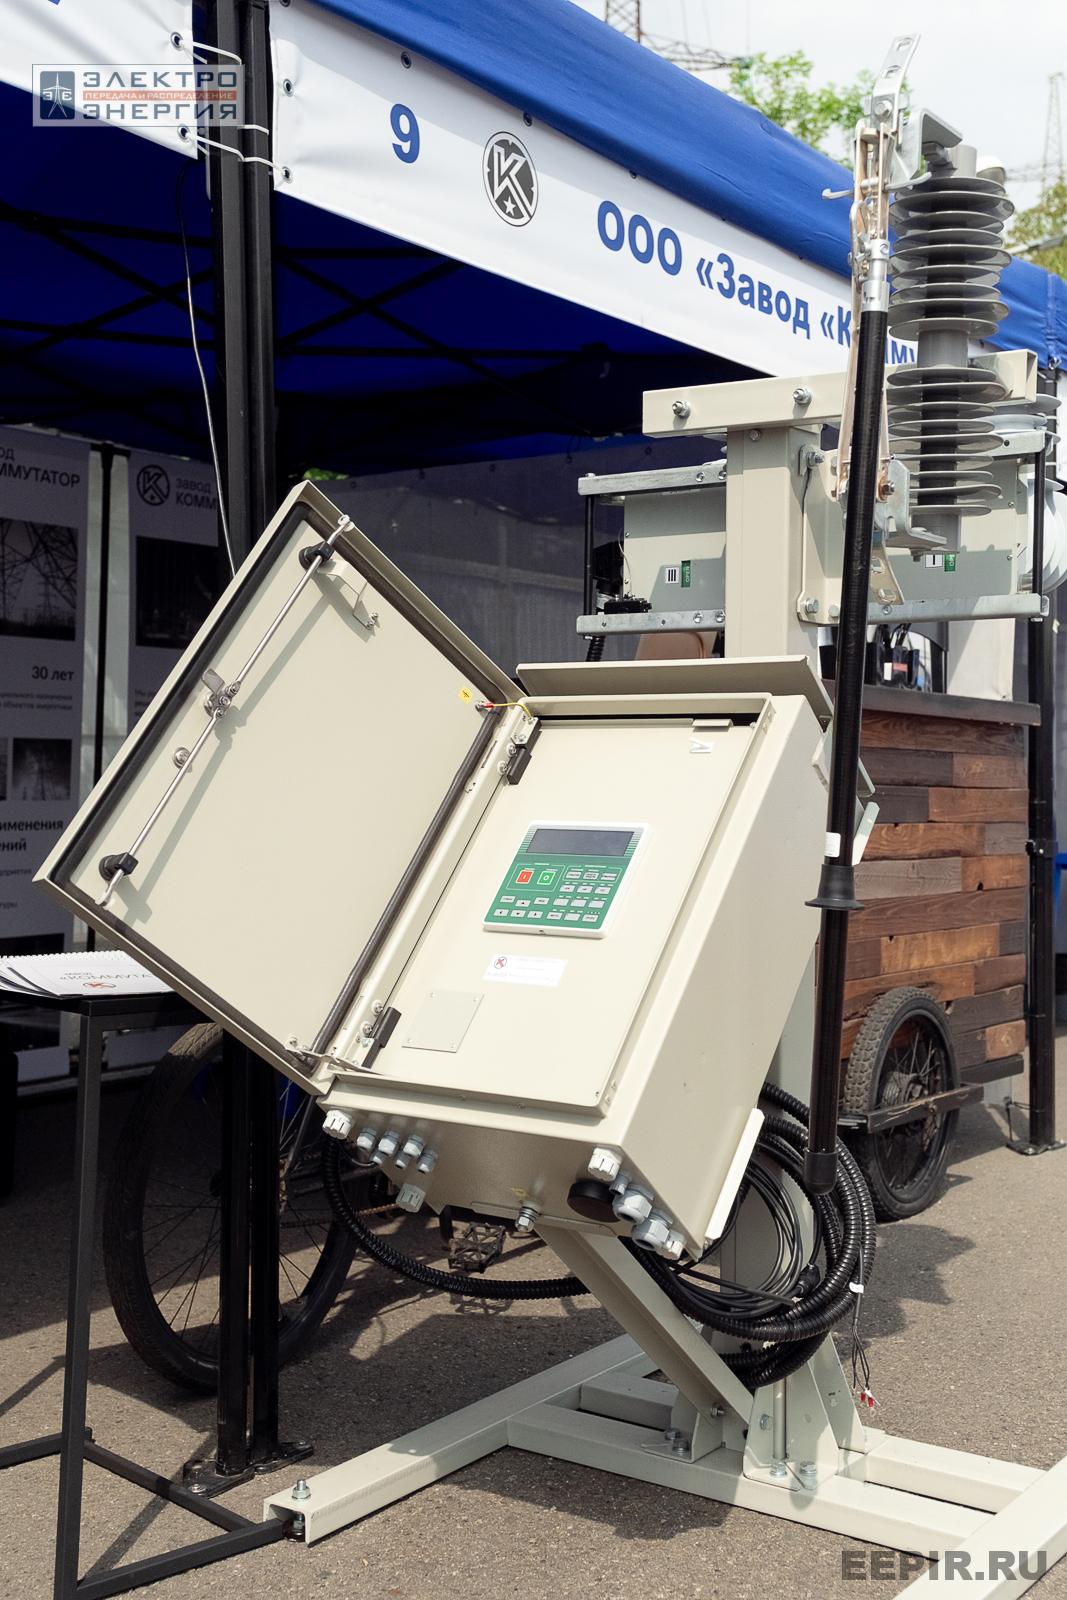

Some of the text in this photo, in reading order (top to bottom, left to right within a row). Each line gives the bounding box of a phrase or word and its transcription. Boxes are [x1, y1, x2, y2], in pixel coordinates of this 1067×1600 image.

[390, 103, 420, 164] 9
[597, 200, 682, 276] ООО
[696, 253, 811, 340] «Завод
[32, 666, 74, 681] 30 лет
